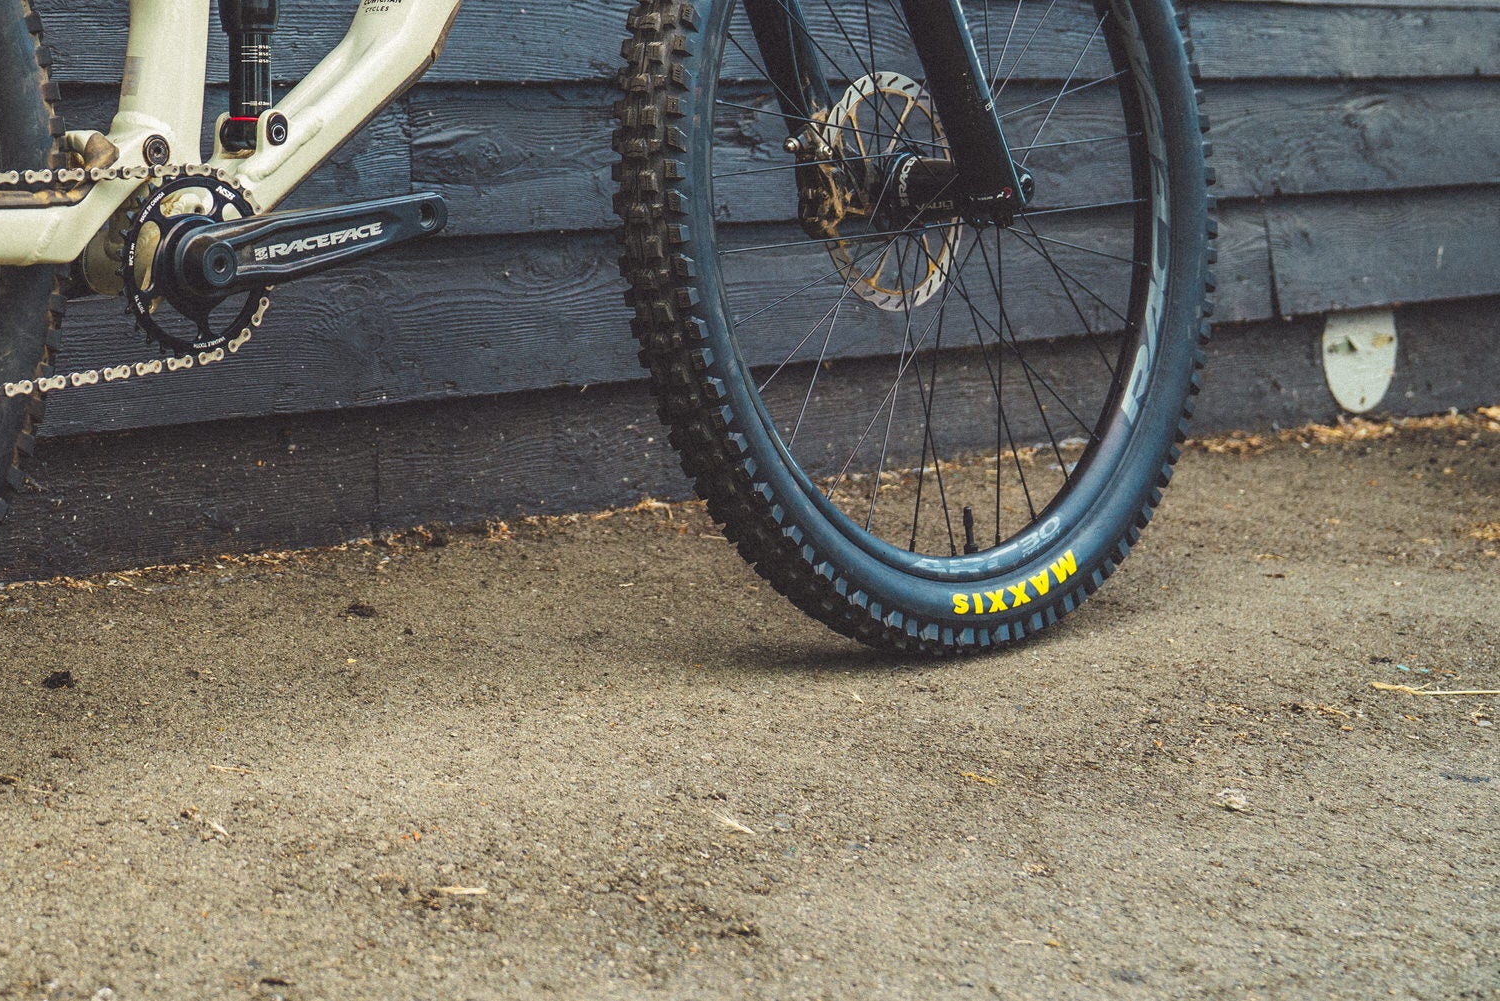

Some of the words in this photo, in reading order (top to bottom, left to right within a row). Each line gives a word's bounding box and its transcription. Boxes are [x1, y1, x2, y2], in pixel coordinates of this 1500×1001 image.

[365, 5, 390, 13] CYCLES
[149, 191, 166, 207] CANADA
[215, 185, 236, 200] NSB
[267, 221, 384, 259] RACEFACE
[1018, 516, 1061, 549] 30
[952, 549, 1078, 615] MAXXIS
